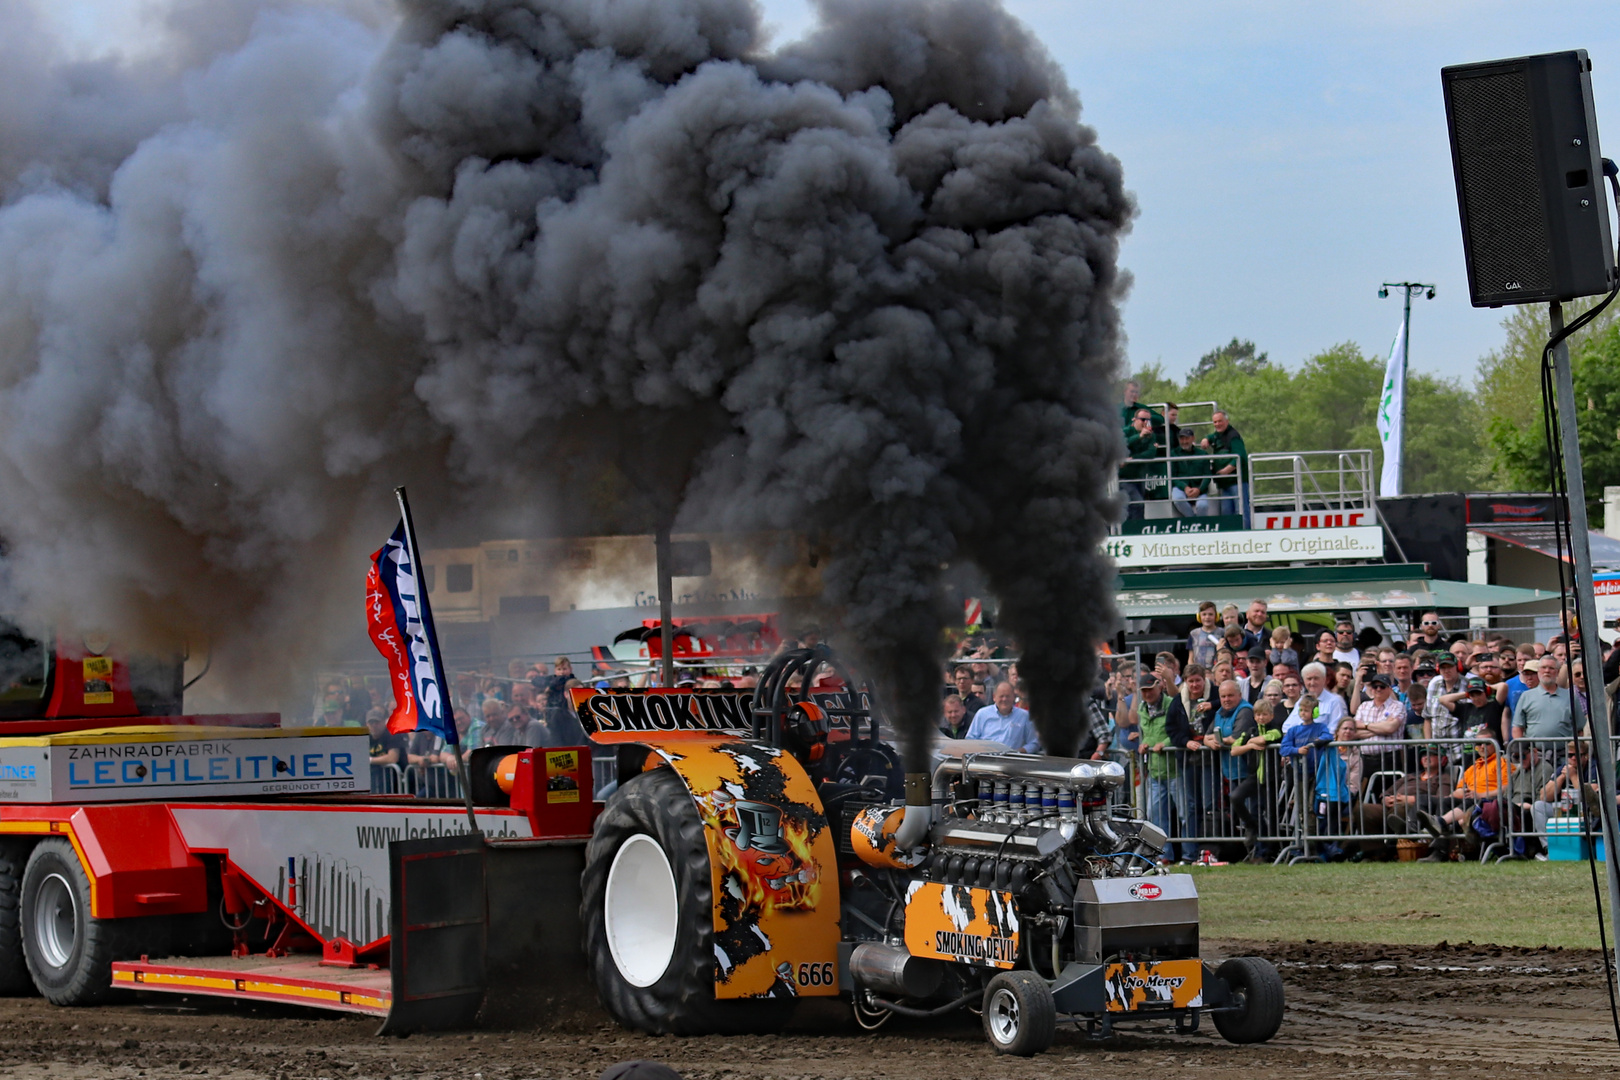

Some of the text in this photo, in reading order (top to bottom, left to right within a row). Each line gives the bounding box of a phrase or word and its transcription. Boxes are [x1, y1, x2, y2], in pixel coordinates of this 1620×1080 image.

[1142, 540, 1272, 558] Münsterländer
[1280, 535, 1376, 555] Originale...
[69, 743, 232, 760] ZAHNRADFABRIK
[69, 753, 353, 785] LECHLEITNER
[262, 781, 355, 792] GEGRÜNDET 1928
[936, 930, 1018, 963] SMOKING DEVIL
[798, 962, 835, 987] 666
[1126, 976, 1185, 988] No Mercy
